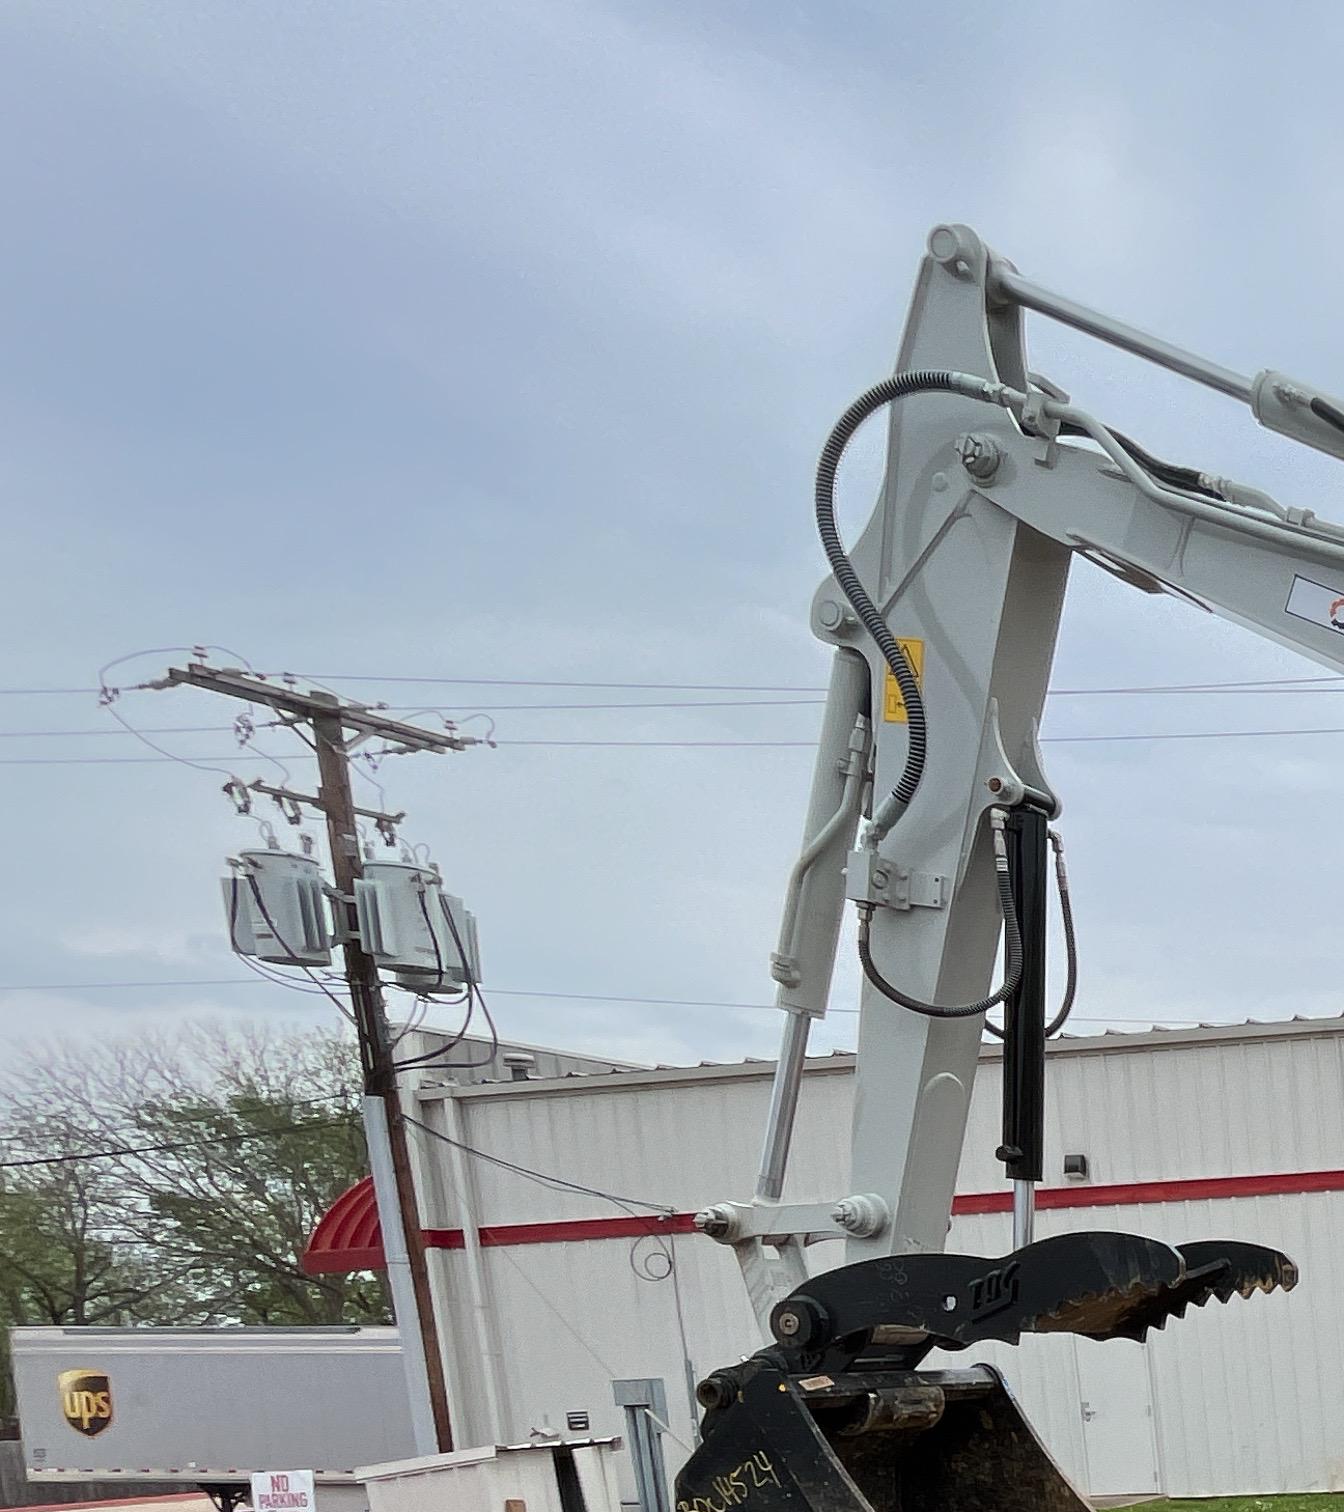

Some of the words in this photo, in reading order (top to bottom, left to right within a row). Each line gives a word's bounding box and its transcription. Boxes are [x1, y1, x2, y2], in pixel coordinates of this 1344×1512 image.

[64, 1391, 112, 1429] ups
[270, 1474, 290, 1493] NO
[258, 1491, 308, 1510] PARKING
